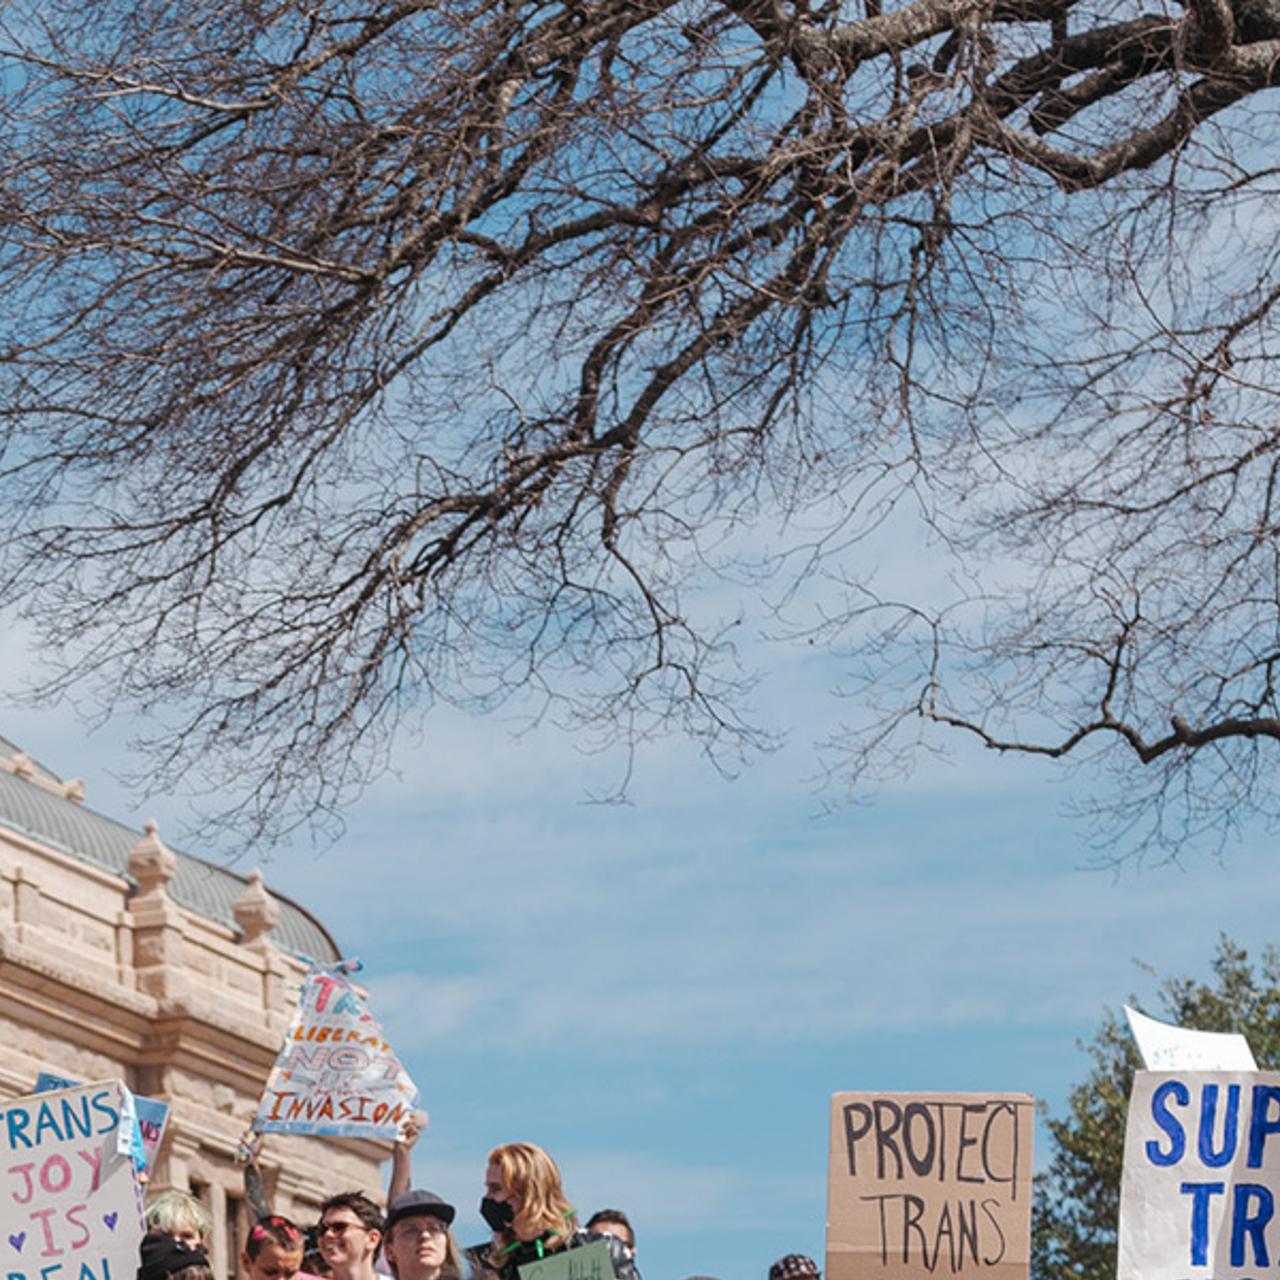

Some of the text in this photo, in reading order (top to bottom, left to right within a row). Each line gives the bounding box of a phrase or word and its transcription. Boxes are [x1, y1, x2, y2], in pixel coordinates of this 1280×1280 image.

[290, 1046, 400, 1081] NOT
[266, 1092, 405, 1125] INVASION
[8, 1147, 101, 1204] JOY
[844, 1100, 1035, 1200] PROTECT
[30, 1204, 90, 1257] IS
[860, 1194, 1005, 1274] TRANS
